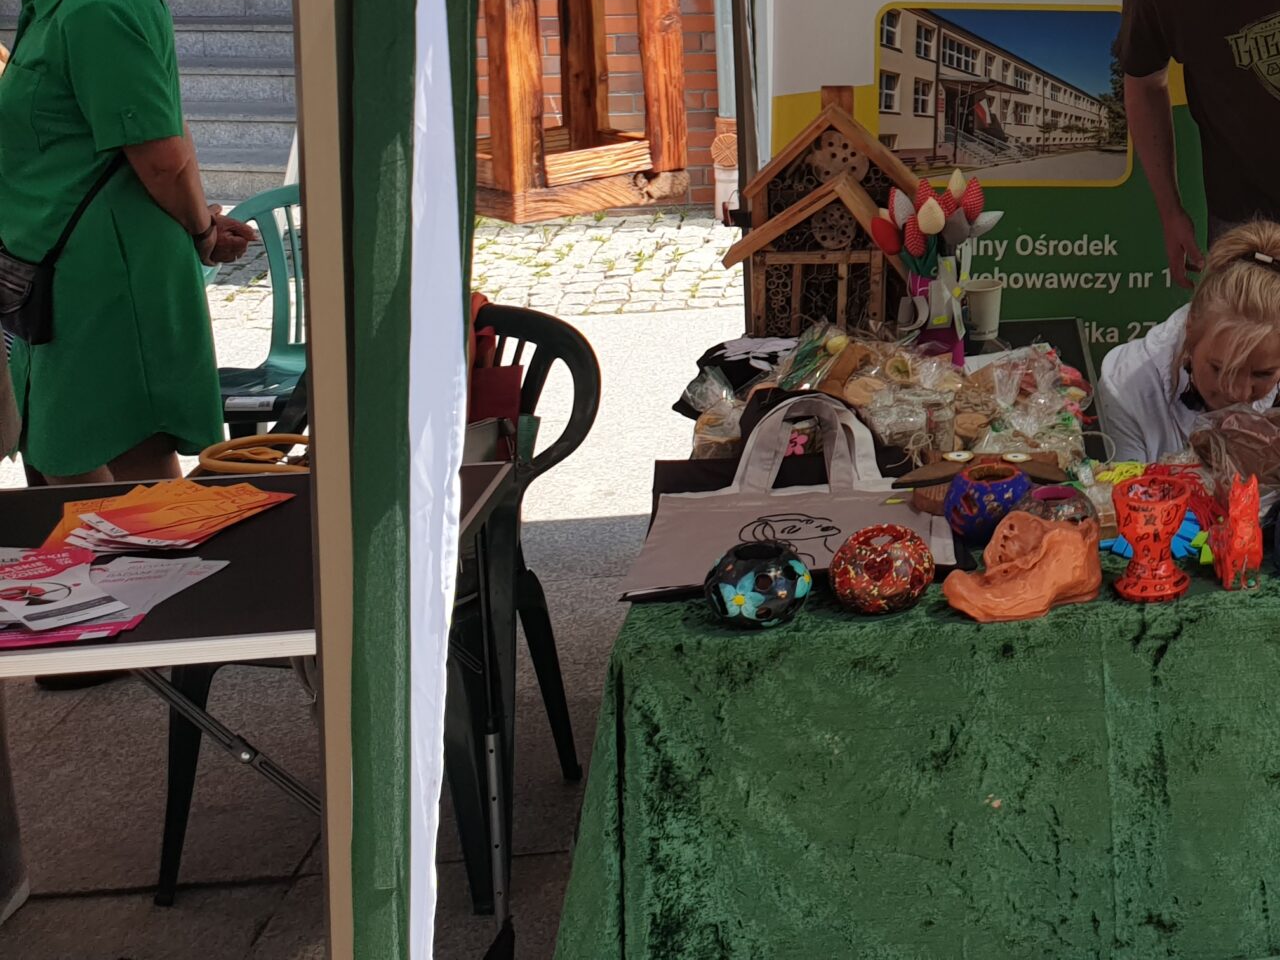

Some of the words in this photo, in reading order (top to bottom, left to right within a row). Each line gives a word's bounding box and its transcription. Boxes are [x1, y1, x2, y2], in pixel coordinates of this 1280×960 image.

[970, 236, 1008, 261] lny
[1015, 233, 1118, 256] Ośrodek
[1128, 272, 1154, 288] nr
[1161, 268, 1172, 288] 1
[1083, 321, 1119, 343] ika
